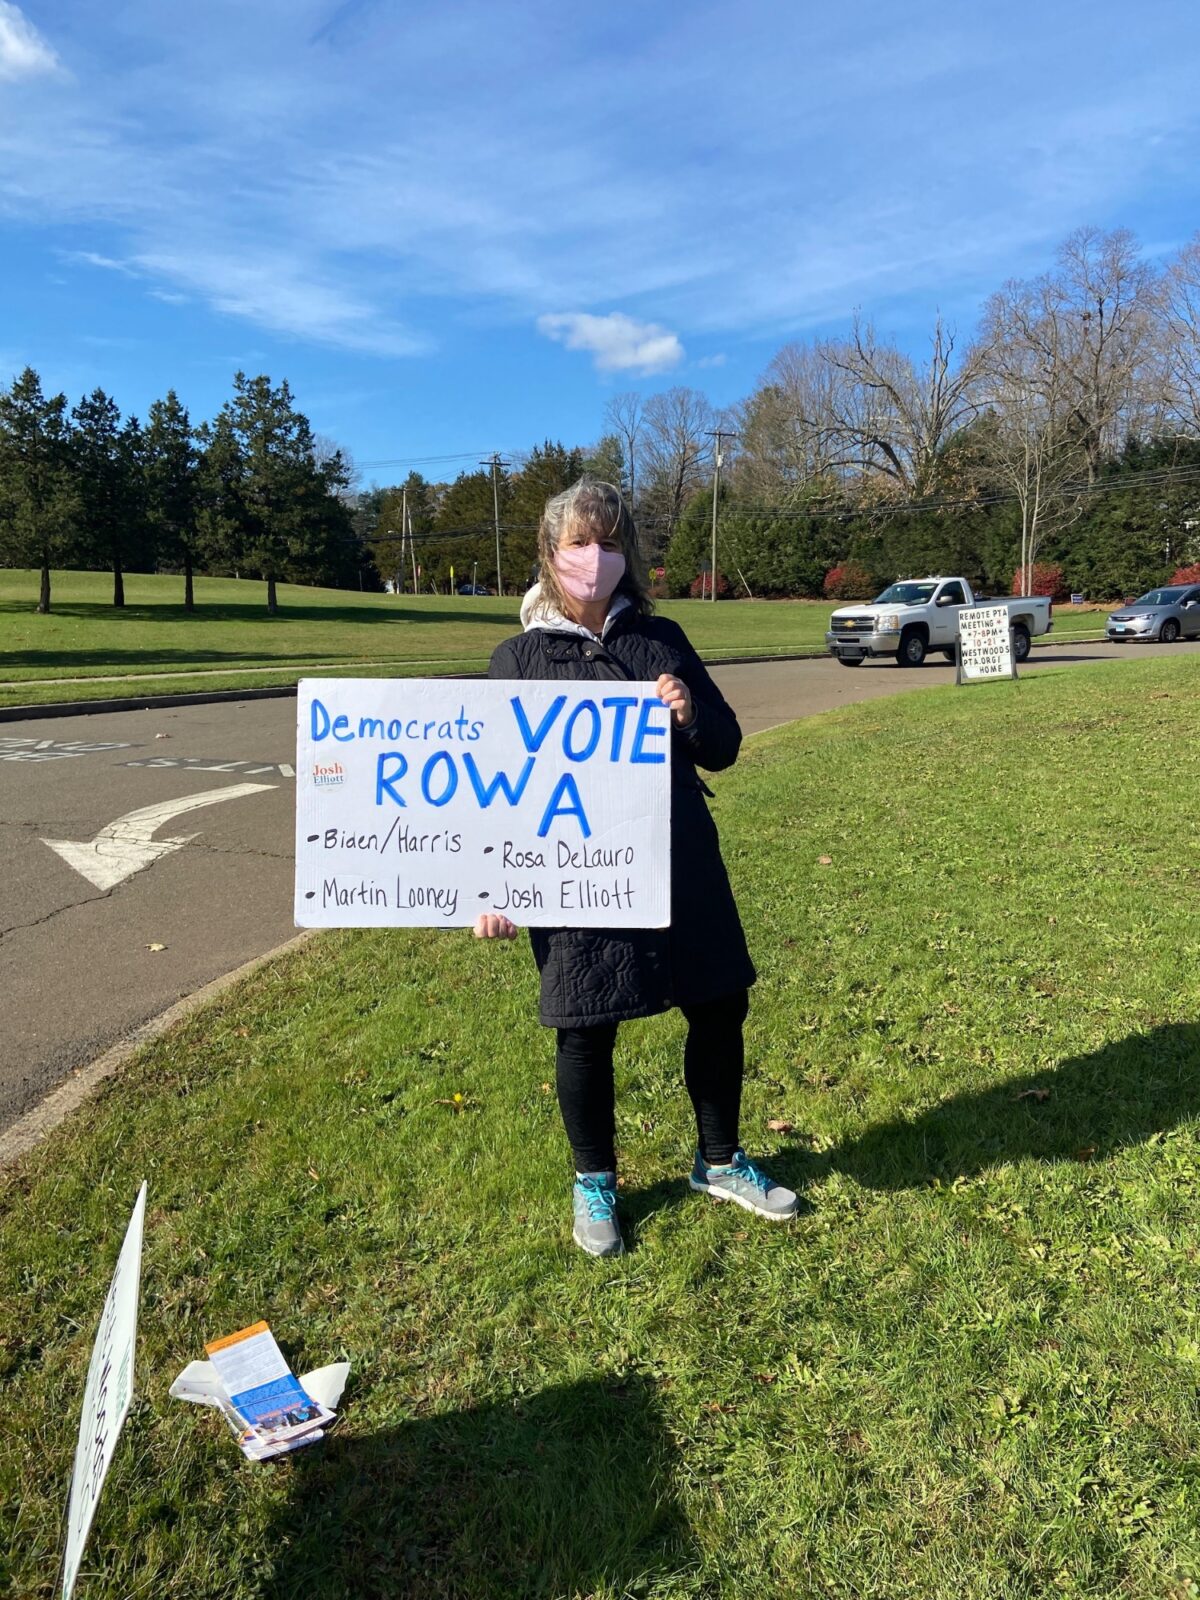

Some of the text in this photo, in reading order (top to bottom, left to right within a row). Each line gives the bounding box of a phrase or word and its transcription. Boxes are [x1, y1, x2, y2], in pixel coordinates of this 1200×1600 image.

[960, 609, 1007, 620] REMOTE PTA
[961, 620, 994, 629] MEETING
[962, 646, 1009, 657] WESTWOODS
[979, 664, 1002, 674] HOME
[311, 695, 670, 763] Democrats VOTE
[312, 762, 343, 775] Josh
[313, 774, 344, 784] Elliott
[376, 750, 592, 838] ROW A
[324, 816, 462, 854] Biden/Harris
[502, 840, 634, 868] Rosa DeLauro
[323, 875, 458, 916] Martin Looney
[493, 878, 635, 909] Josh Elliott
